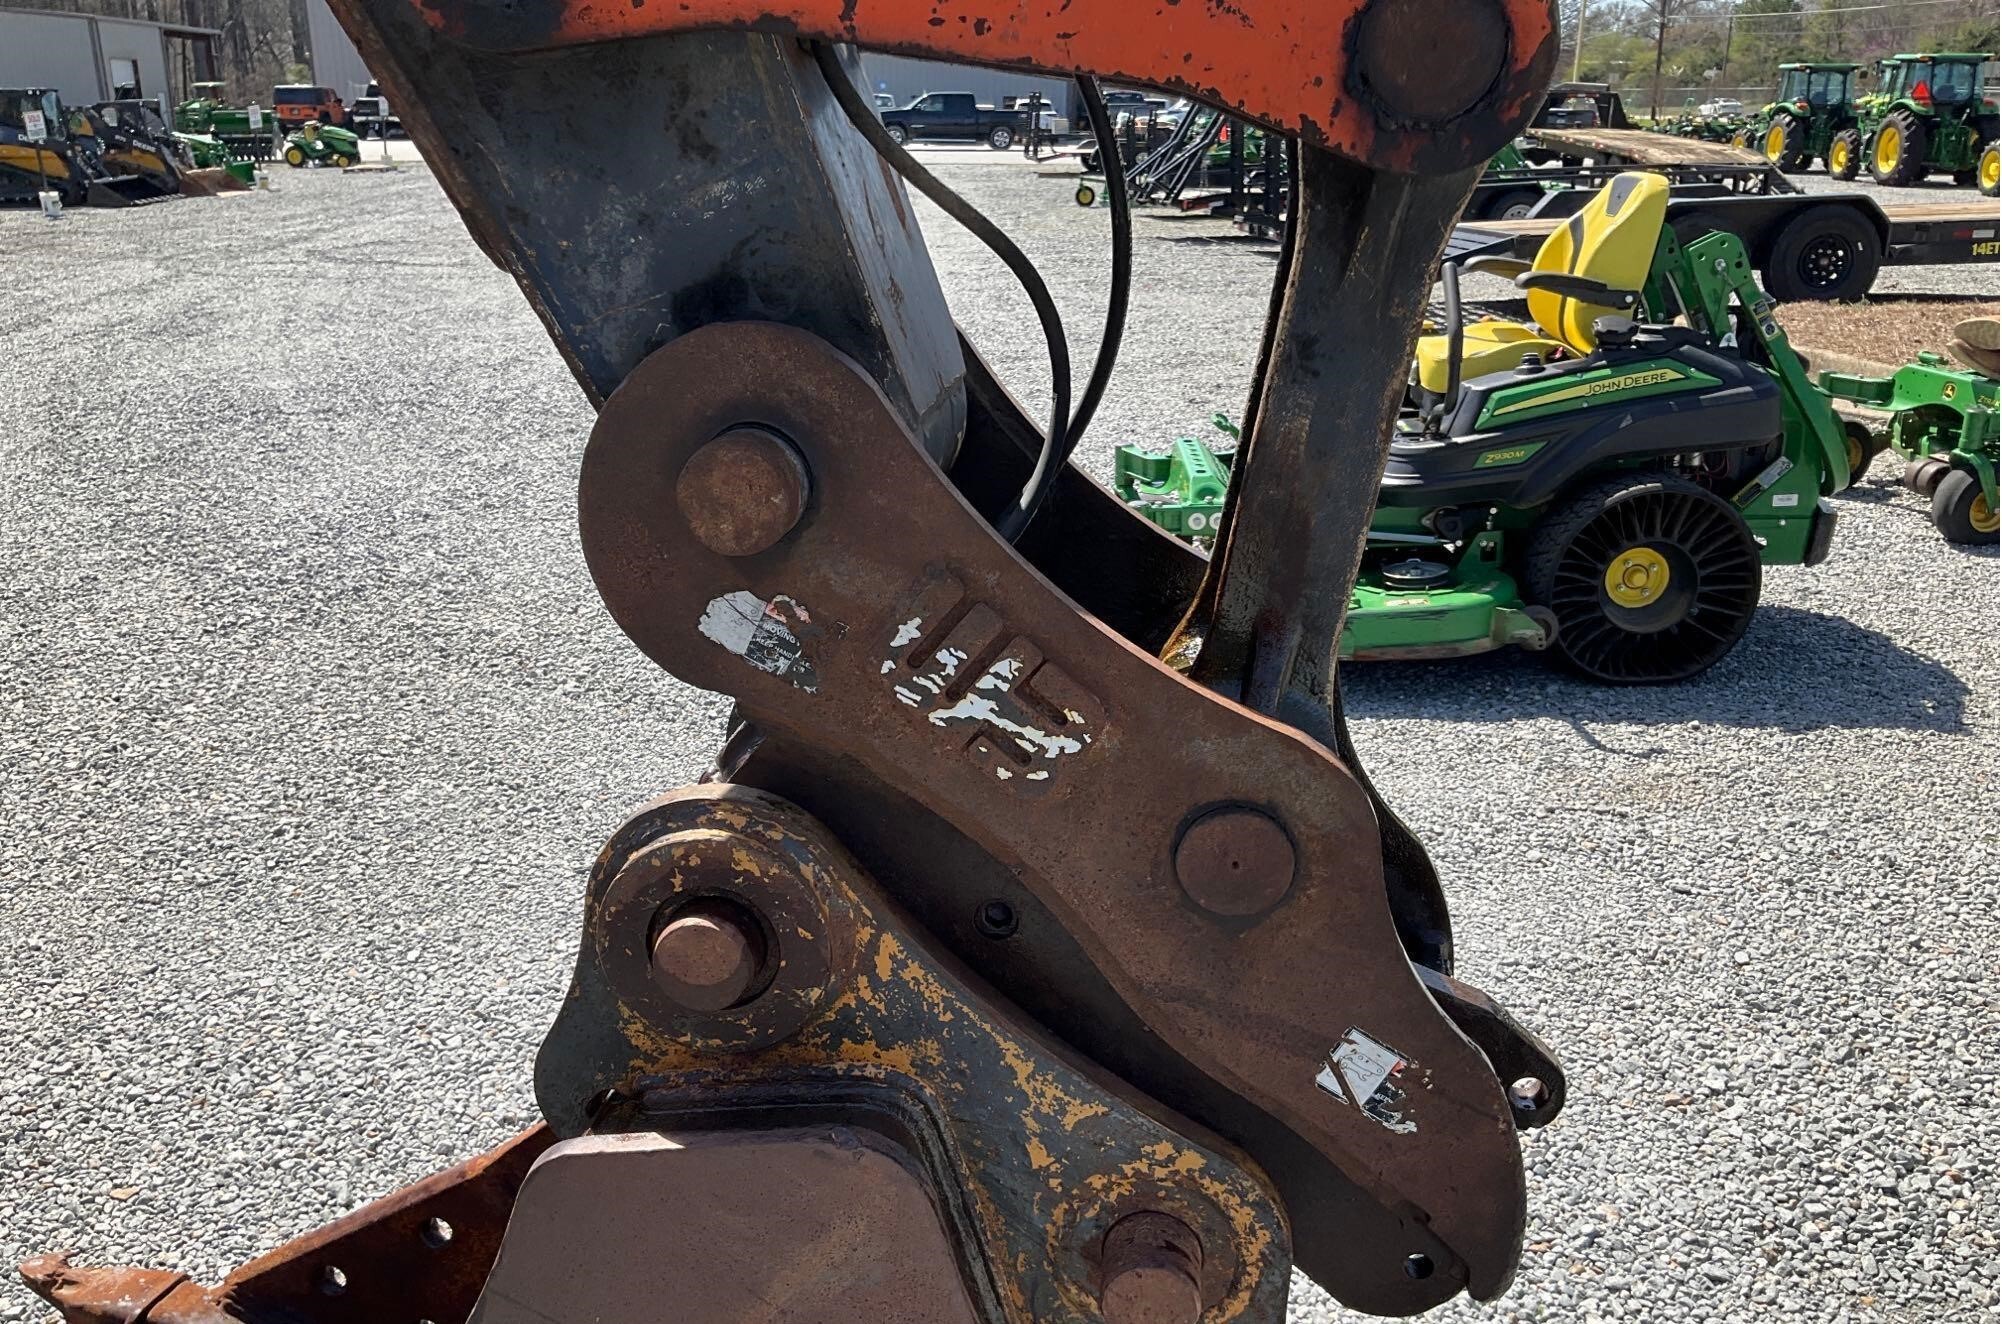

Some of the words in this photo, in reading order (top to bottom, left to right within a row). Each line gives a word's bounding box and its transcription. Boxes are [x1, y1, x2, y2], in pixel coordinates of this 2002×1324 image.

[1585, 380, 1620, 395] JOHN
[1624, 372, 1668, 387] DEERE
[1484, 450, 1525, 464] Z930M
[762, 622, 796, 644] MOVING
